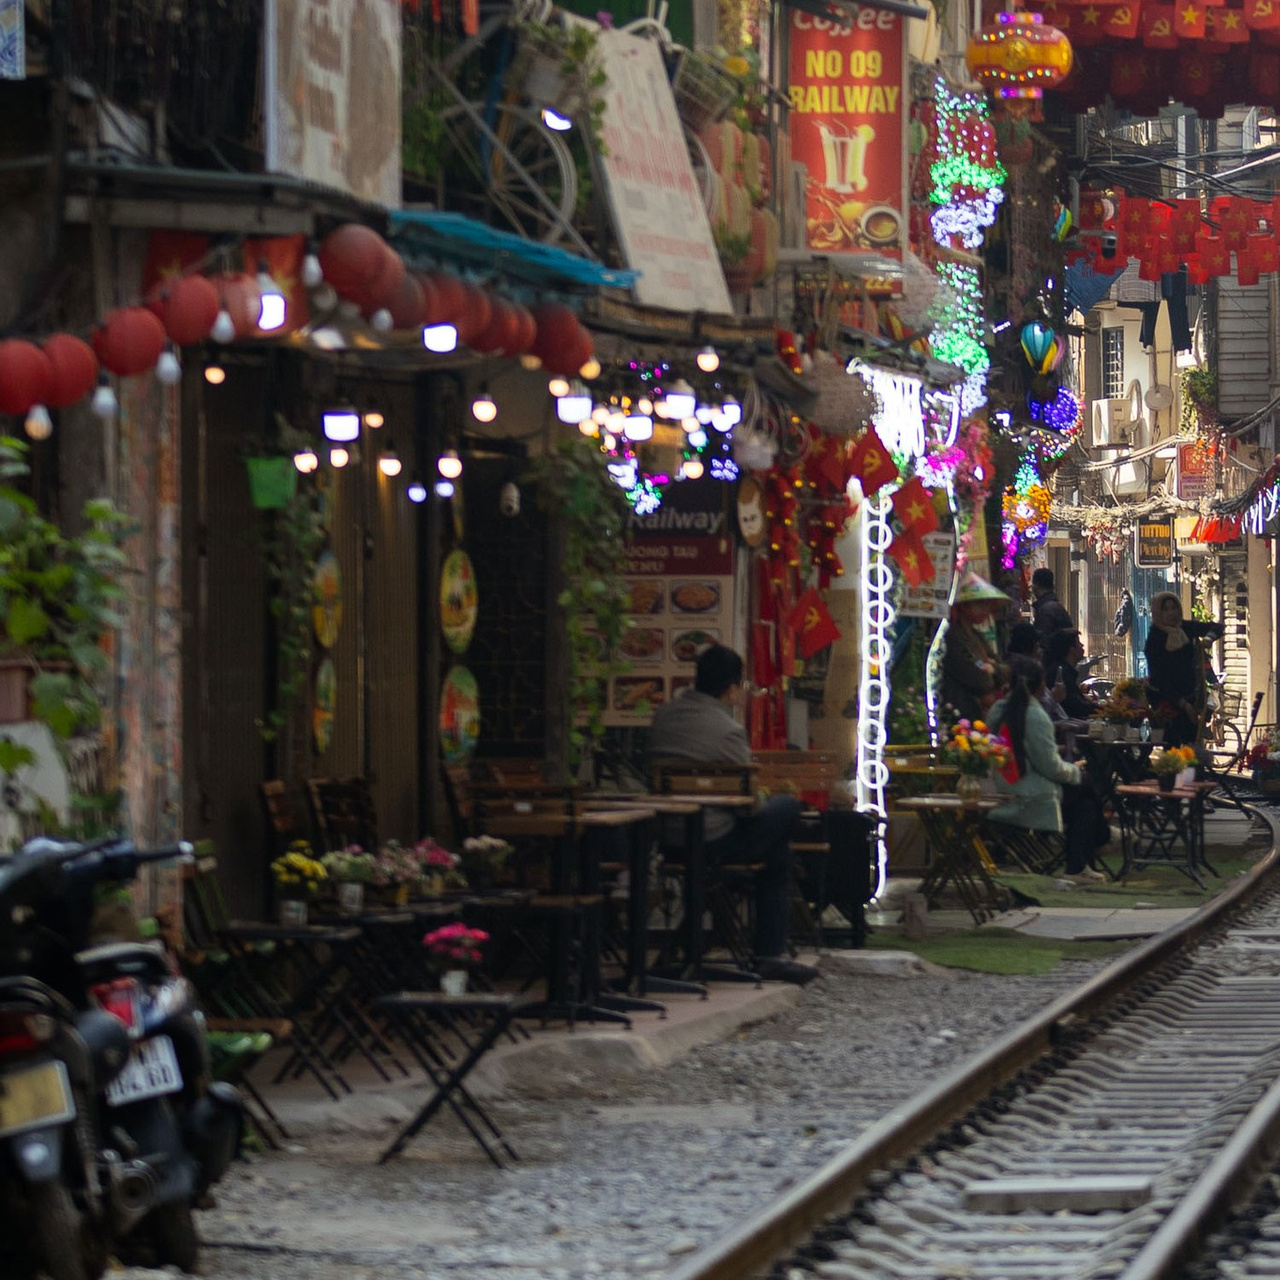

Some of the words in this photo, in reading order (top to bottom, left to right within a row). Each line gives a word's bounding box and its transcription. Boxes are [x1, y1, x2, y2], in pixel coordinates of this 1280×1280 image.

[806, 50, 843, 78] NO
[850, 50, 882, 78] 09
[789, 85, 900, 114] RAILWAY
[626, 506, 722, 535] Railway
[1139, 524, 1170, 538] TATTOO
